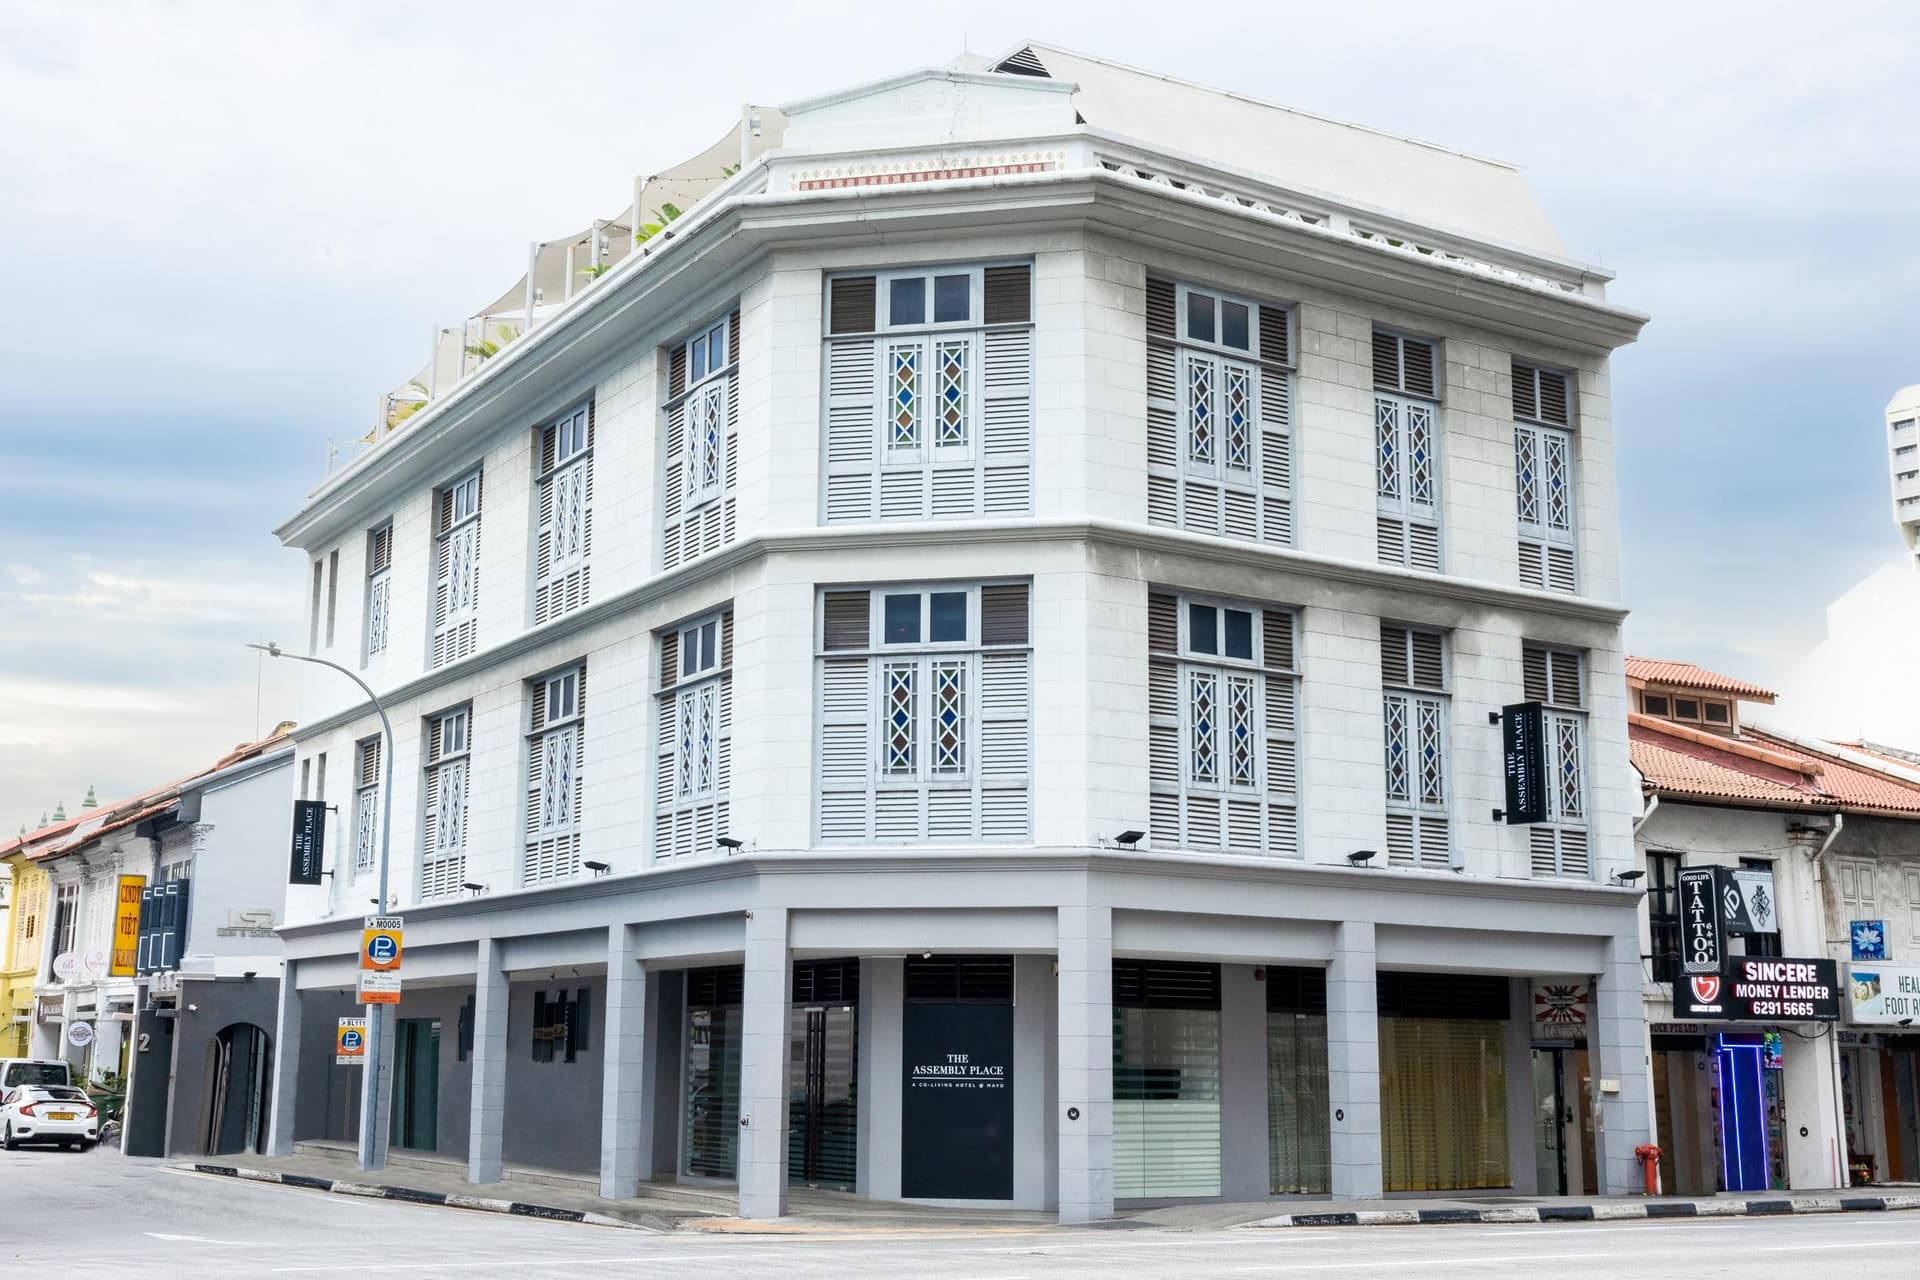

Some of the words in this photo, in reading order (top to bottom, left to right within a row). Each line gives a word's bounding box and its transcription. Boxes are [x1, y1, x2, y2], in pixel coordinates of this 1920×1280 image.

[1514, 713, 1524, 750] PLACE
[1507, 753, 1515, 776] THE
[1516, 755, 1526, 813] ASSEMBLY
[304, 807, 314, 834] PLACE
[295, 833, 304, 851] THE
[302, 836, 313, 878] ASSEMBLY
[120, 884, 142, 903] CINDY
[376, 920, 401, 929] M0005
[1689, 881, 1709, 965] TATTOO
[1745, 962, 1818, 983] SINCERE
[1735, 984, 1781, 998] MONEY
[1783, 985, 1829, 1000] LENDER
[1753, 1001, 1781, 1015] 6291
[1783, 1002, 1814, 1016] 5665
[1884, 997, 1909, 1015] FOOT
[138, 1033, 151, 1052] 2
[946, 1054, 969, 1064] THE
[912, 1065, 967, 1075] ASSEMBLY
[969, 1066, 1004, 1076] PLACE
